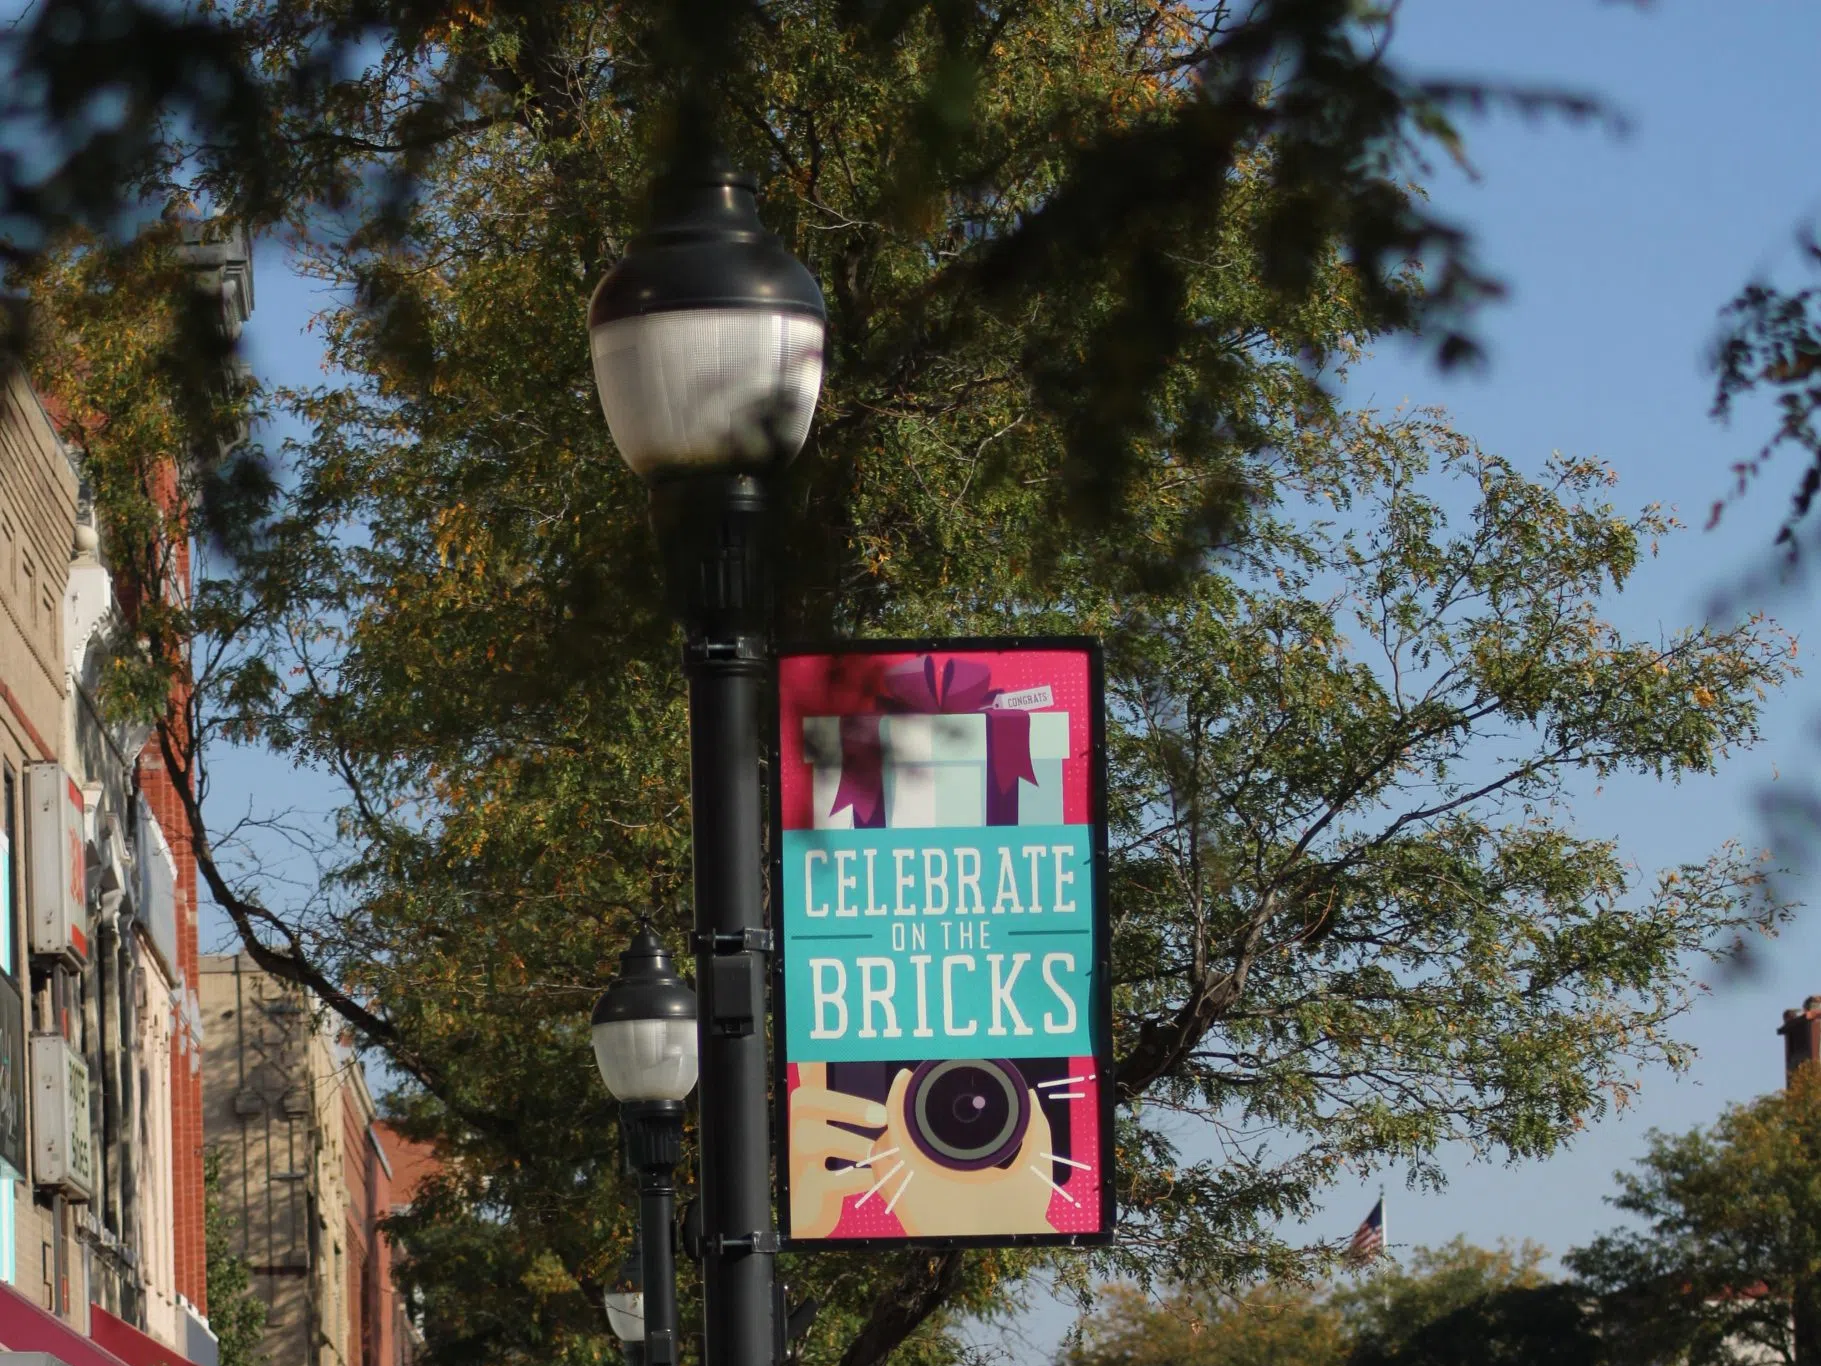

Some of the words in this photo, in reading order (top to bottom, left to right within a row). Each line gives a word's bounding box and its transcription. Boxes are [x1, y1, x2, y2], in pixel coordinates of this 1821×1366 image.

[1007, 692, 1048, 708] CONGRATS
[805, 846, 1076, 917] CELEBRATE
[892, 921, 926, 952] ON
[940, 921, 990, 951] THE
[809, 952, 1077, 1040] BRICKS
